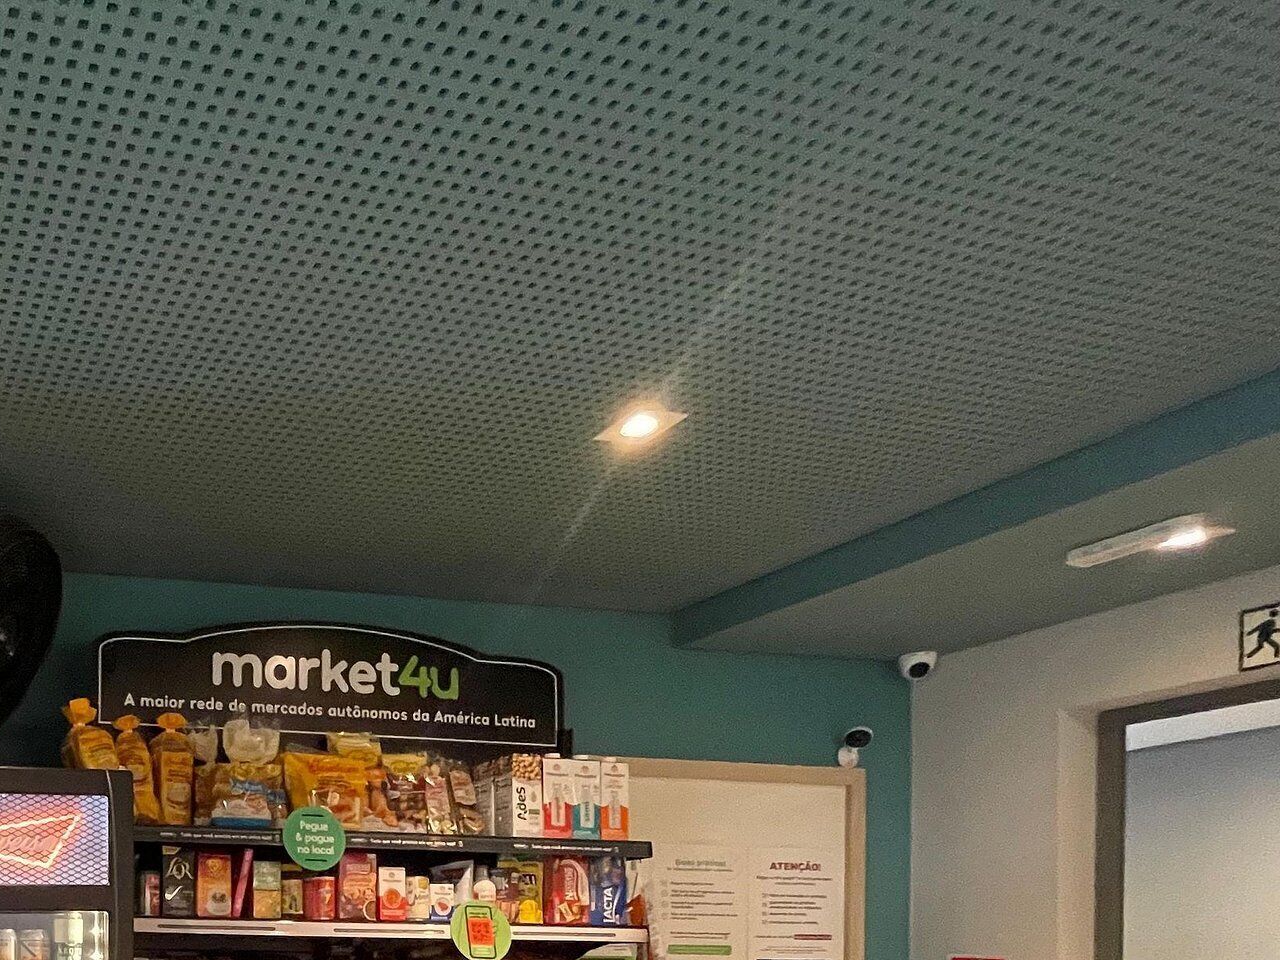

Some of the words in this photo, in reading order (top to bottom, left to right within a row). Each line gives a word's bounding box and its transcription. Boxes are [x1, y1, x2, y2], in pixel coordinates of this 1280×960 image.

[212, 648, 460, 700] market4u
[124, 693, 136, 706] A
[140, 694, 185, 709] maior
[189, 697, 225, 711] rede
[228, 698, 247, 713] de
[251, 700, 324, 716] mercados
[328, 703, 408, 722] autônomos
[412, 709, 430, 723] da
[433, 708, 491, 726] América
[494, 713, 537, 728] Latina
[300, 820, 328, 832] Pegue
[304, 834, 335, 844] pague
[297, 846, 310, 854] no
[311, 845, 335, 855] local
[769, 861, 821, 873] ATENÇÃO!
[602, 887, 615, 924] LACTA
